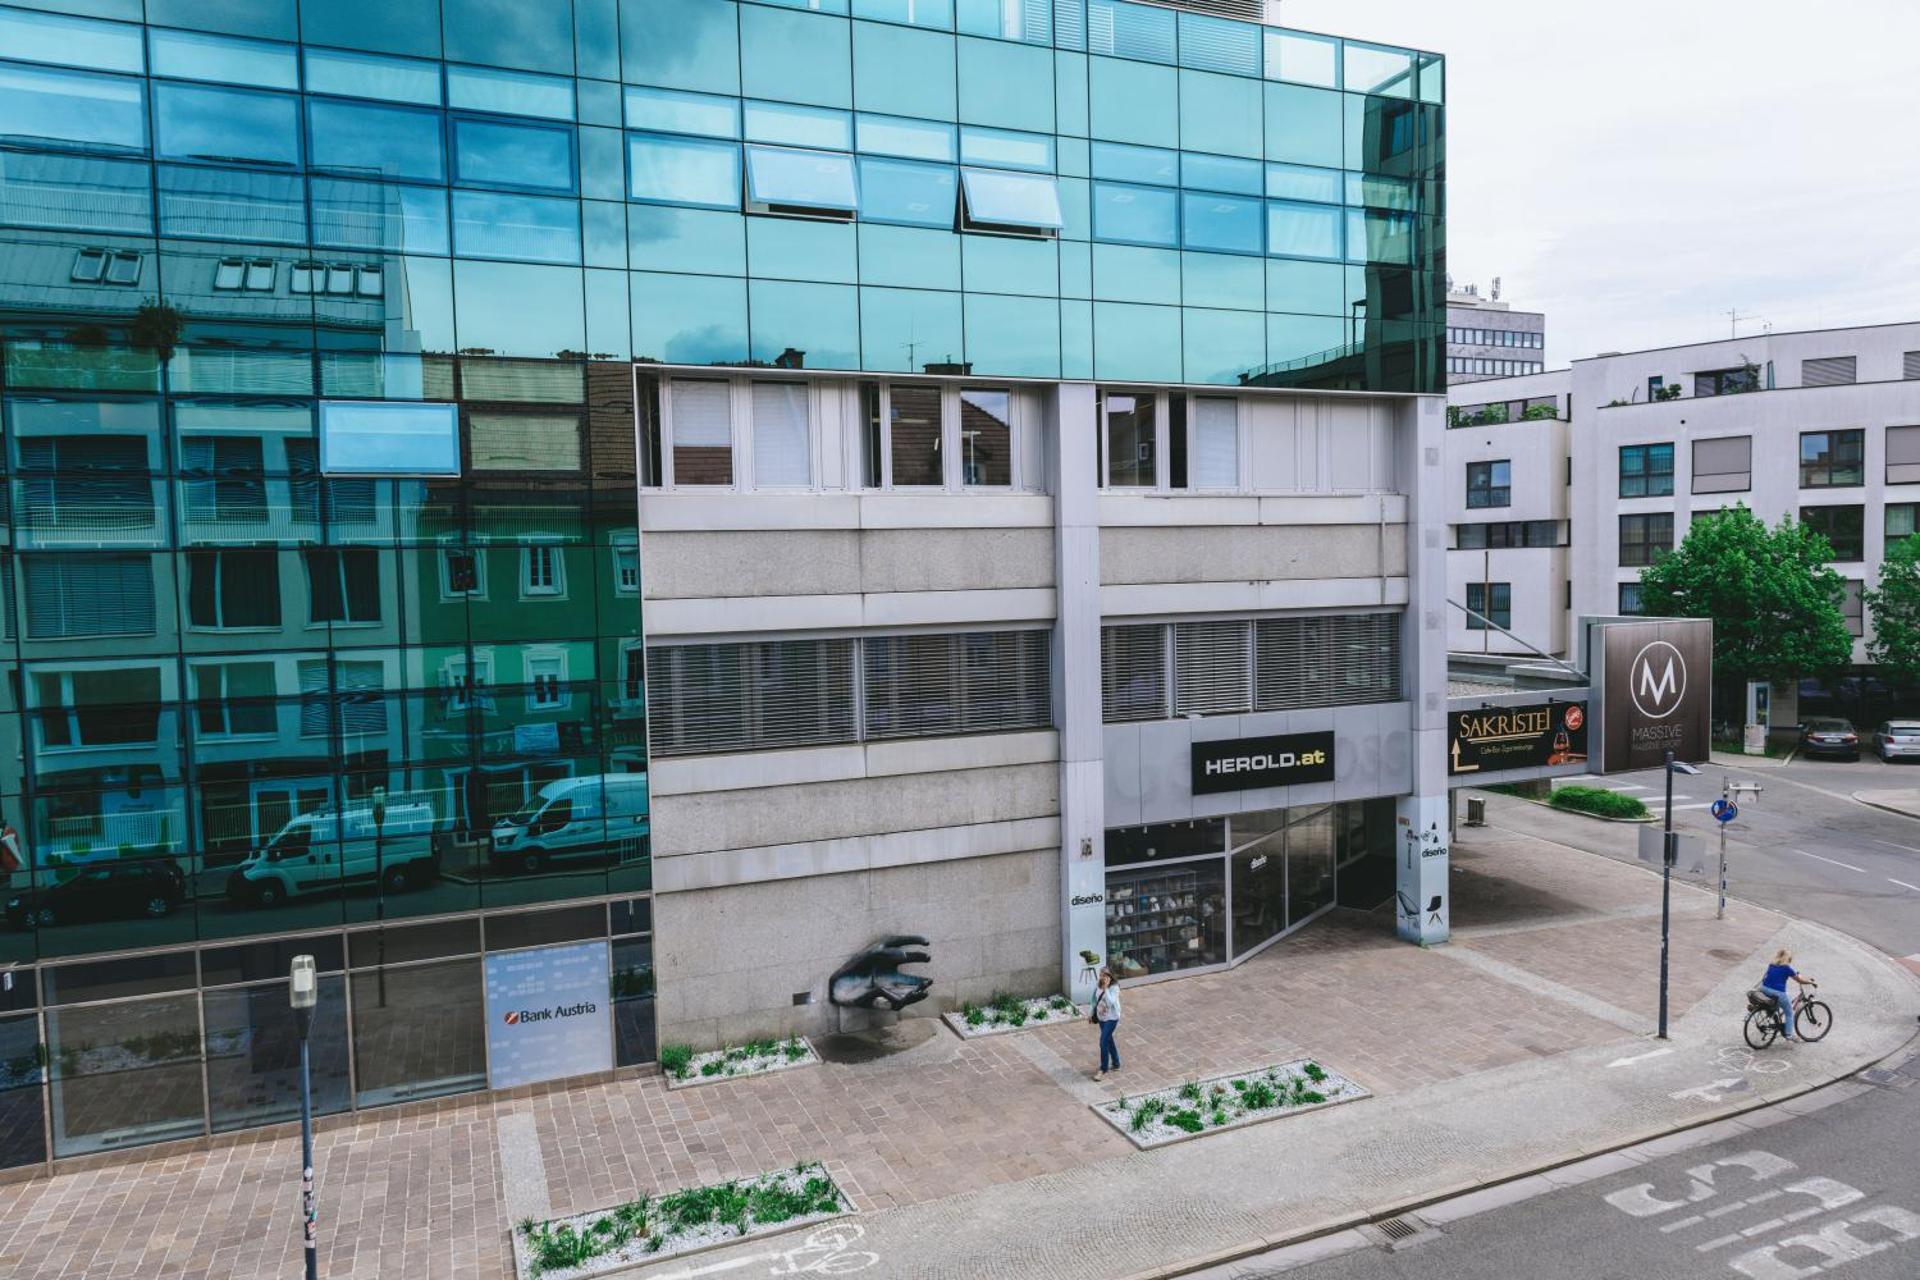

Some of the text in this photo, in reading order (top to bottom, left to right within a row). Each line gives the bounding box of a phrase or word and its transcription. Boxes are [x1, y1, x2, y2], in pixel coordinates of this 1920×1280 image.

[1460, 707, 1551, 738] SAKRISTEI
[1632, 723, 1683, 741] MASSIVE
[1205, 750, 1325, 775] HEROLD.at
[1421, 846, 1447, 858] diseño
[1071, 893, 1103, 906] diseño
[520, 1001, 596, 1023] Bank Austria
